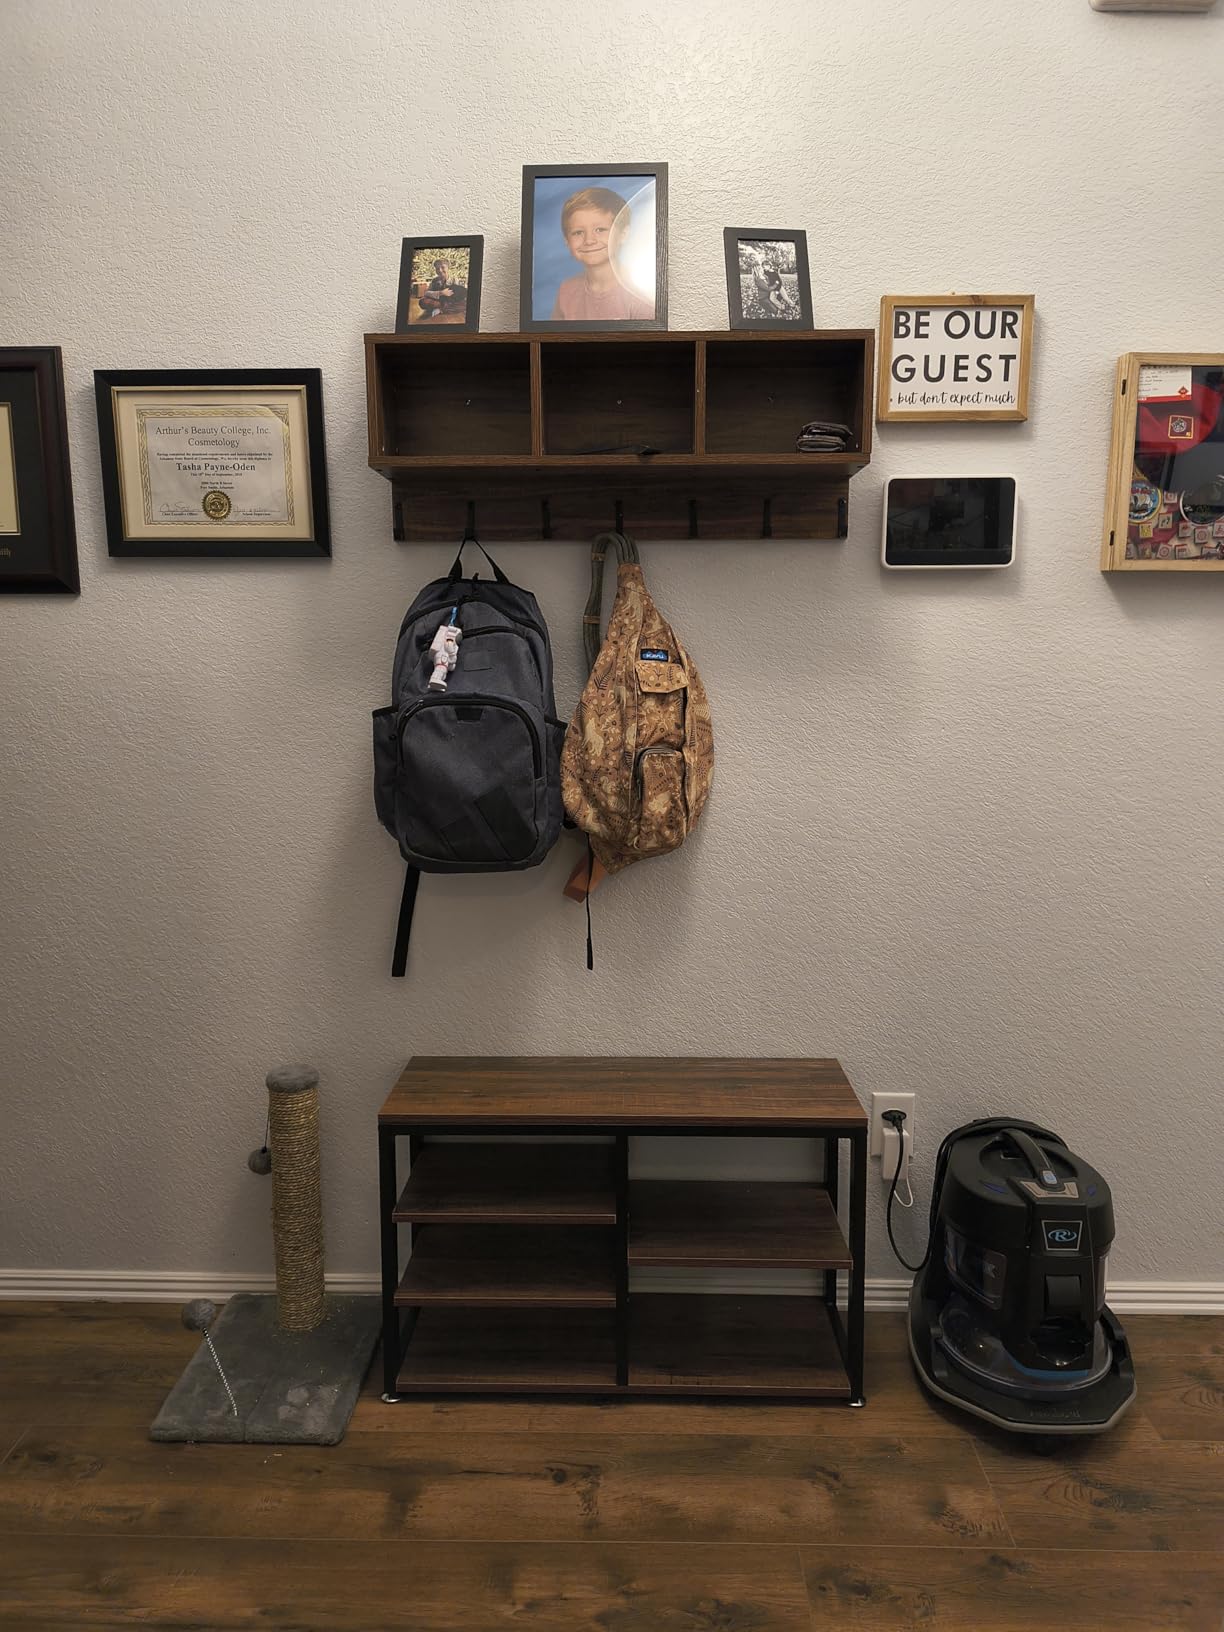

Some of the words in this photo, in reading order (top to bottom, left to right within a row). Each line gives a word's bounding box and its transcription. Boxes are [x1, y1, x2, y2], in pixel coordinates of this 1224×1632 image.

[893, 310, 931, 340] BE
[943, 309, 1019, 340] OUR
[891, 353, 1017, 383] GUEST
[897, 391, 918, 405] but
[949, 391, 983, 406] expect
[984, 390, 1015, 405] much
[155, 426, 189, 435] Arthur's
[191, 426, 218, 436] Beauty
[220, 425, 254, 437] College,
[256, 425, 272, 434] Inc.
[188, 437, 240, 448] Cosmetology
[175, 462, 202, 471] Tasha
[204, 462, 256, 473] Payne-Oden
